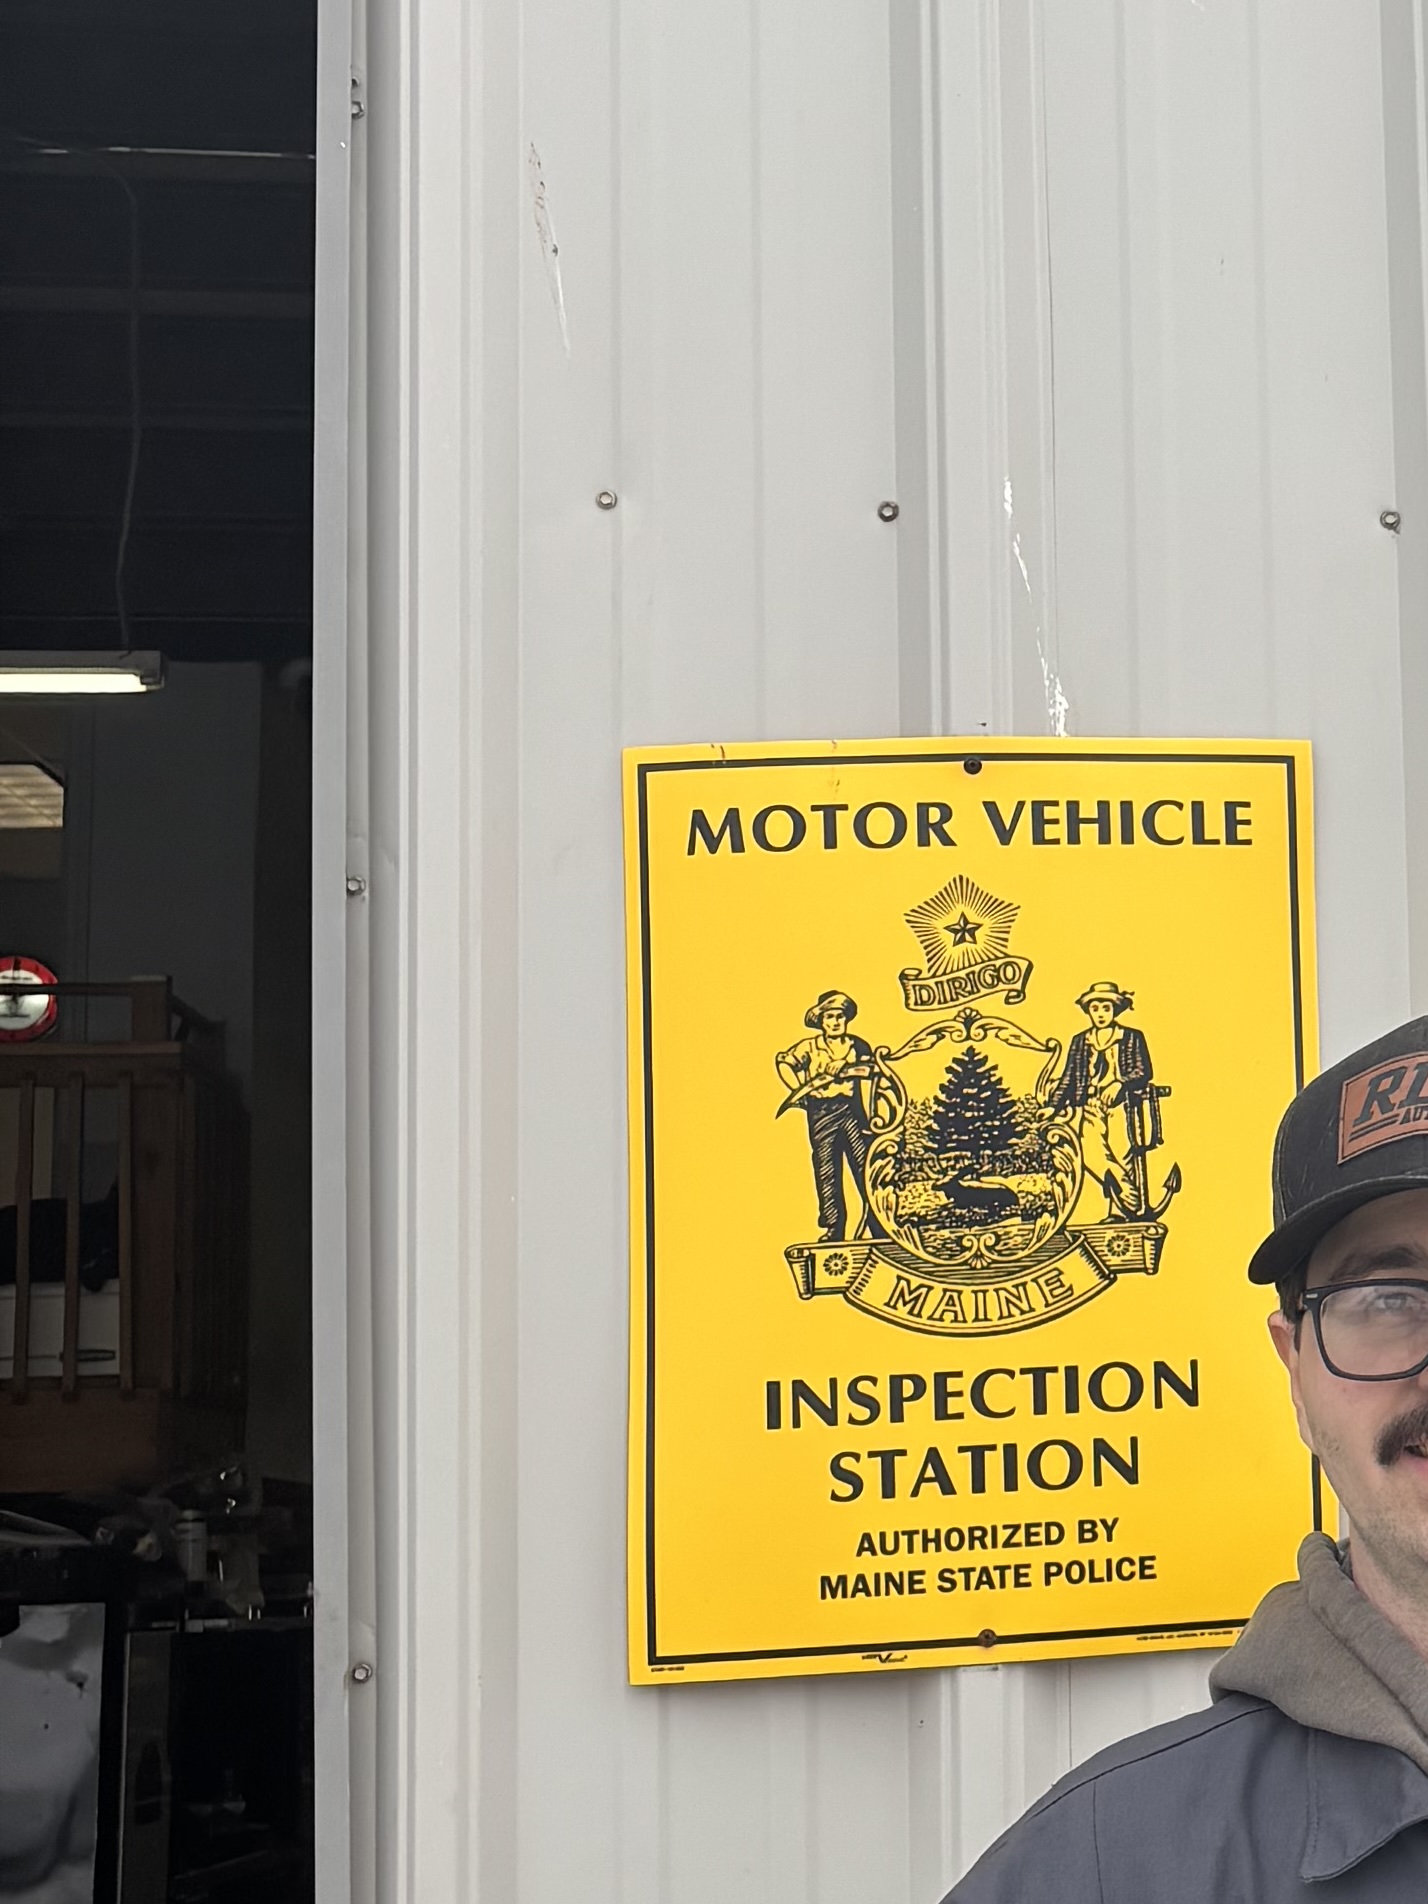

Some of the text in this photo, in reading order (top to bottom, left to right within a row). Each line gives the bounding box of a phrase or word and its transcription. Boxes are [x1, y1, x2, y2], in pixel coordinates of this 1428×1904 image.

[687, 799, 1253, 856] MOTOR VEHICLE
[912, 960, 1022, 1007] DIRIGO
[883, 1266, 1075, 1324] MAINE
[766, 1359, 1199, 1430] INSPECTION
[829, 1436, 1139, 1503] STATION
[855, 1517, 1119, 1558] AUTHORIZED BY
[820, 1555, 1158, 1601] MAINE STATE POLICE
